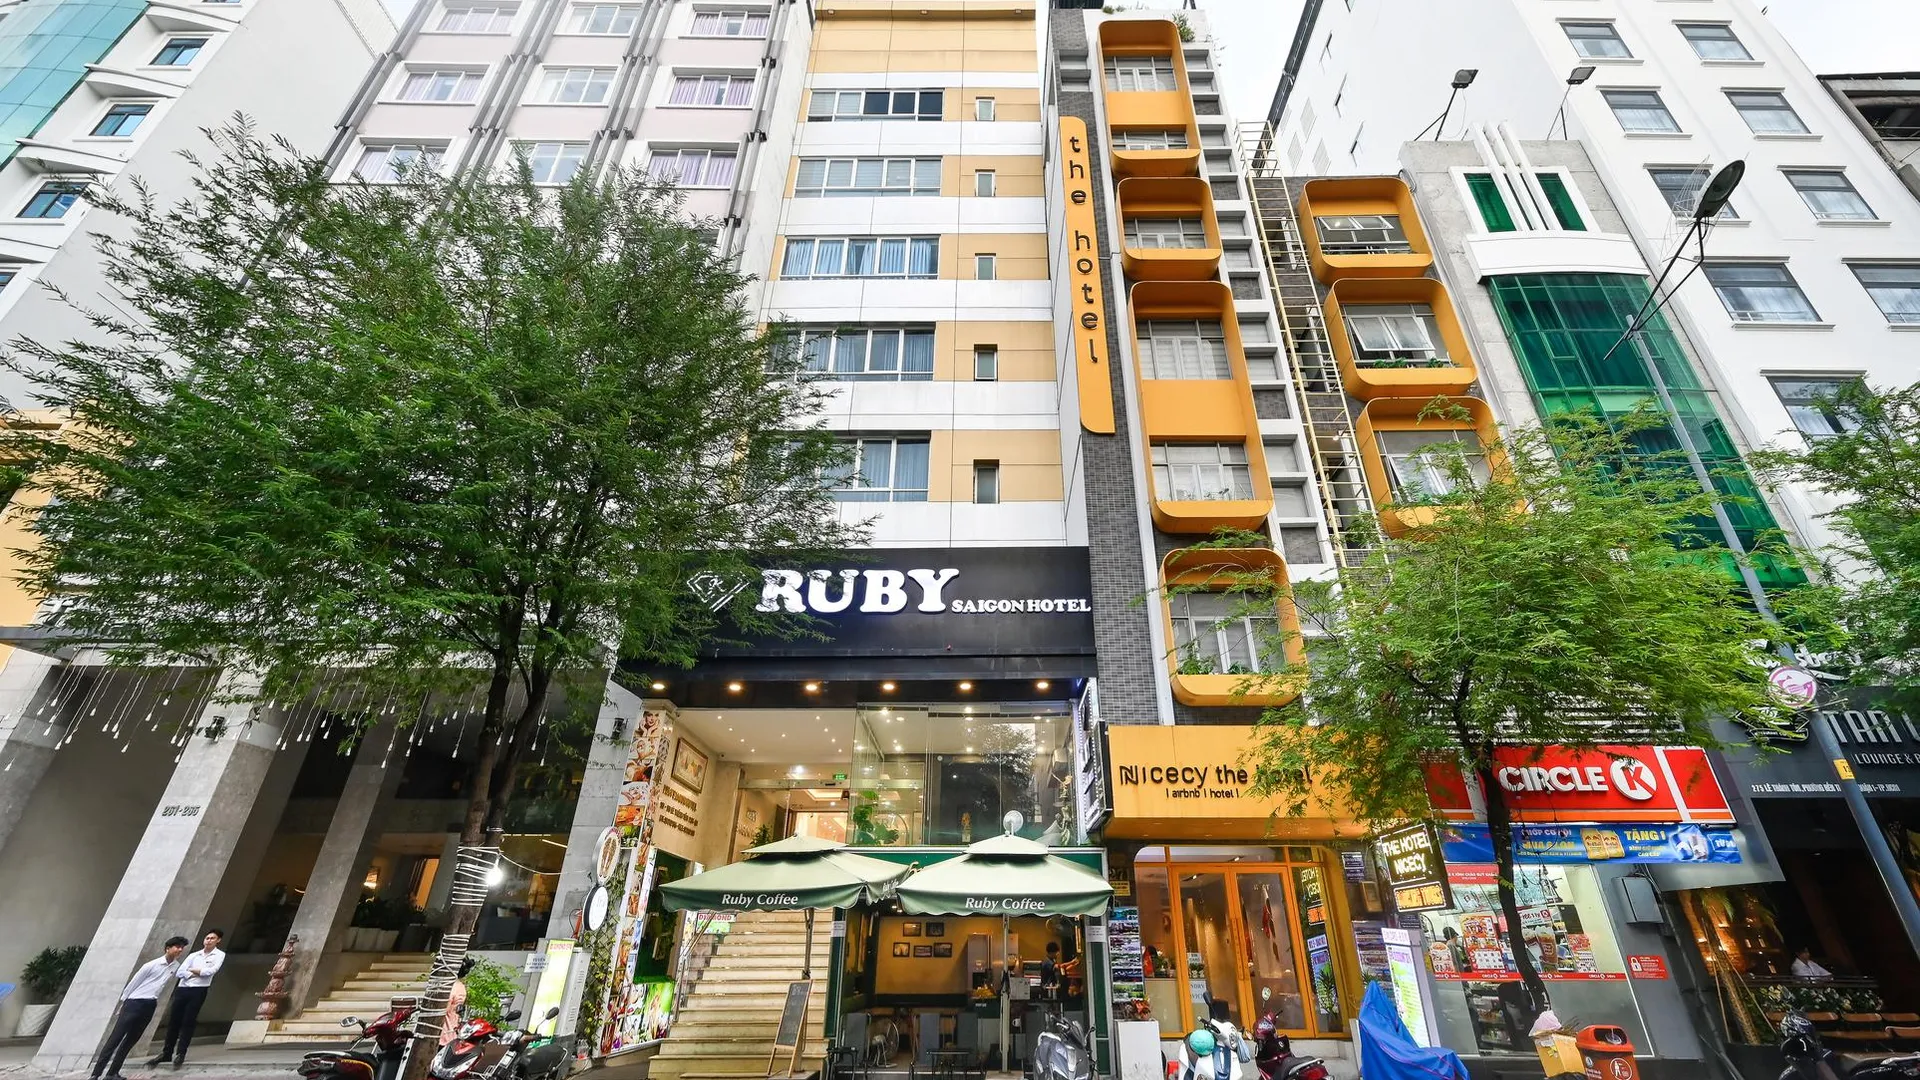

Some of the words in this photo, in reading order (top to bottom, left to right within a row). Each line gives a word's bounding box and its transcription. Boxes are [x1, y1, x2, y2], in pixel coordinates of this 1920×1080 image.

[1069, 136, 1087, 205] the
[1074, 230, 1099, 364] hotel
[755, 568, 960, 613] RUBY
[951, 599, 1026, 614] SAIGON
[1026, 599, 1092, 613] HOTEL
[1853, 753, 1905, 765] LOUNGE
[1215, 765, 1248, 784] the
[1498, 766, 1609, 792] CIRCLE
[1617, 763, 1657, 797] K
[1171, 788, 1201, 798] airbnb
[1209, 788, 1234, 798] hotel
[1751, 784, 1764, 792] 275
[1382, 839, 1401, 857] THE
[1399, 832, 1431, 853] HOTEL
[1624, 828, 1660, 844] TẶNG
[1393, 852, 1427, 875] NICECY
[721, 893, 754, 908] Ruby
[756, 893, 799, 905] Coffee
[965, 897, 999, 912] Ruby
[1002, 897, 1046, 910] Coffee
